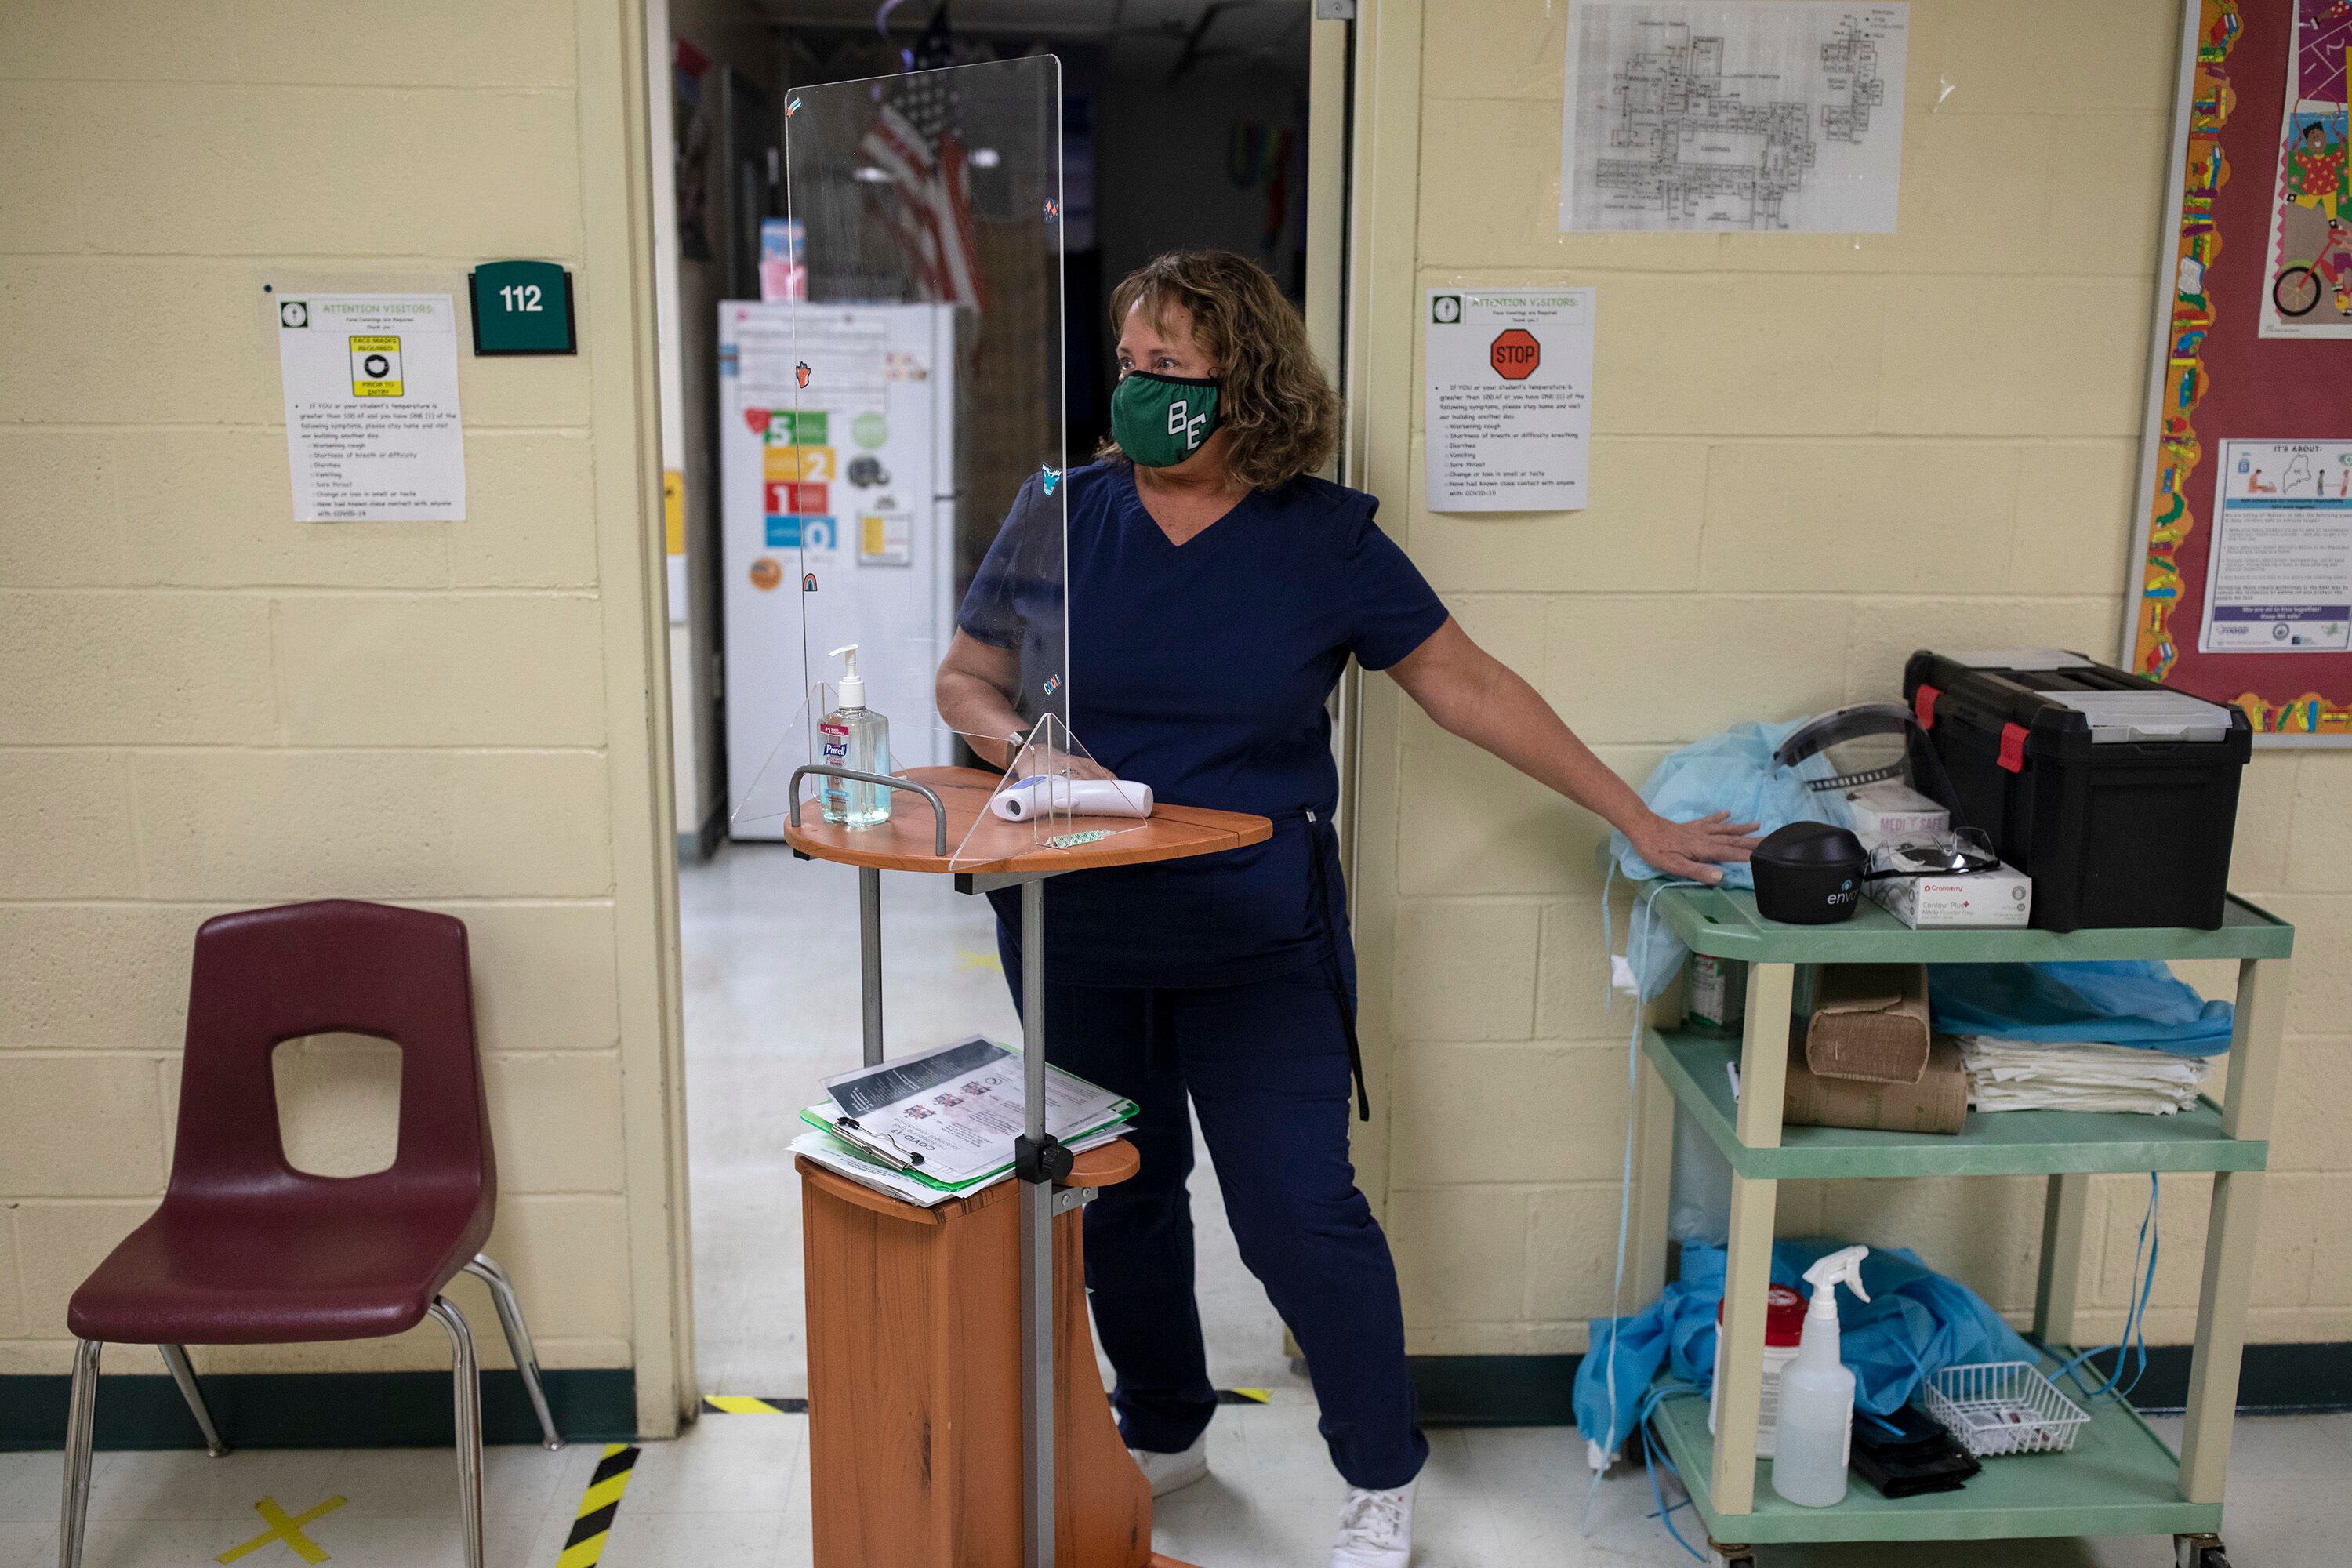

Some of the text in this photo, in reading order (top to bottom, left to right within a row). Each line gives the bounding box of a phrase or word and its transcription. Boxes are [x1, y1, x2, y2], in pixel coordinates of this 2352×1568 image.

[323, 304, 379, 313] ATTENTION
[499, 285, 543, 312] 112
[1497, 346, 1535, 364] STOP
[769, 416, 790, 446] 5
[808, 453, 828, 481] 2
[772, 485, 789, 514] 1
[804, 521, 830, 550] 0
[1044, 674, 1061, 695] COOL!
[1881, 817, 1946, 831] MEDI SAFE
[891, 1129, 935, 1150] COVID-19
